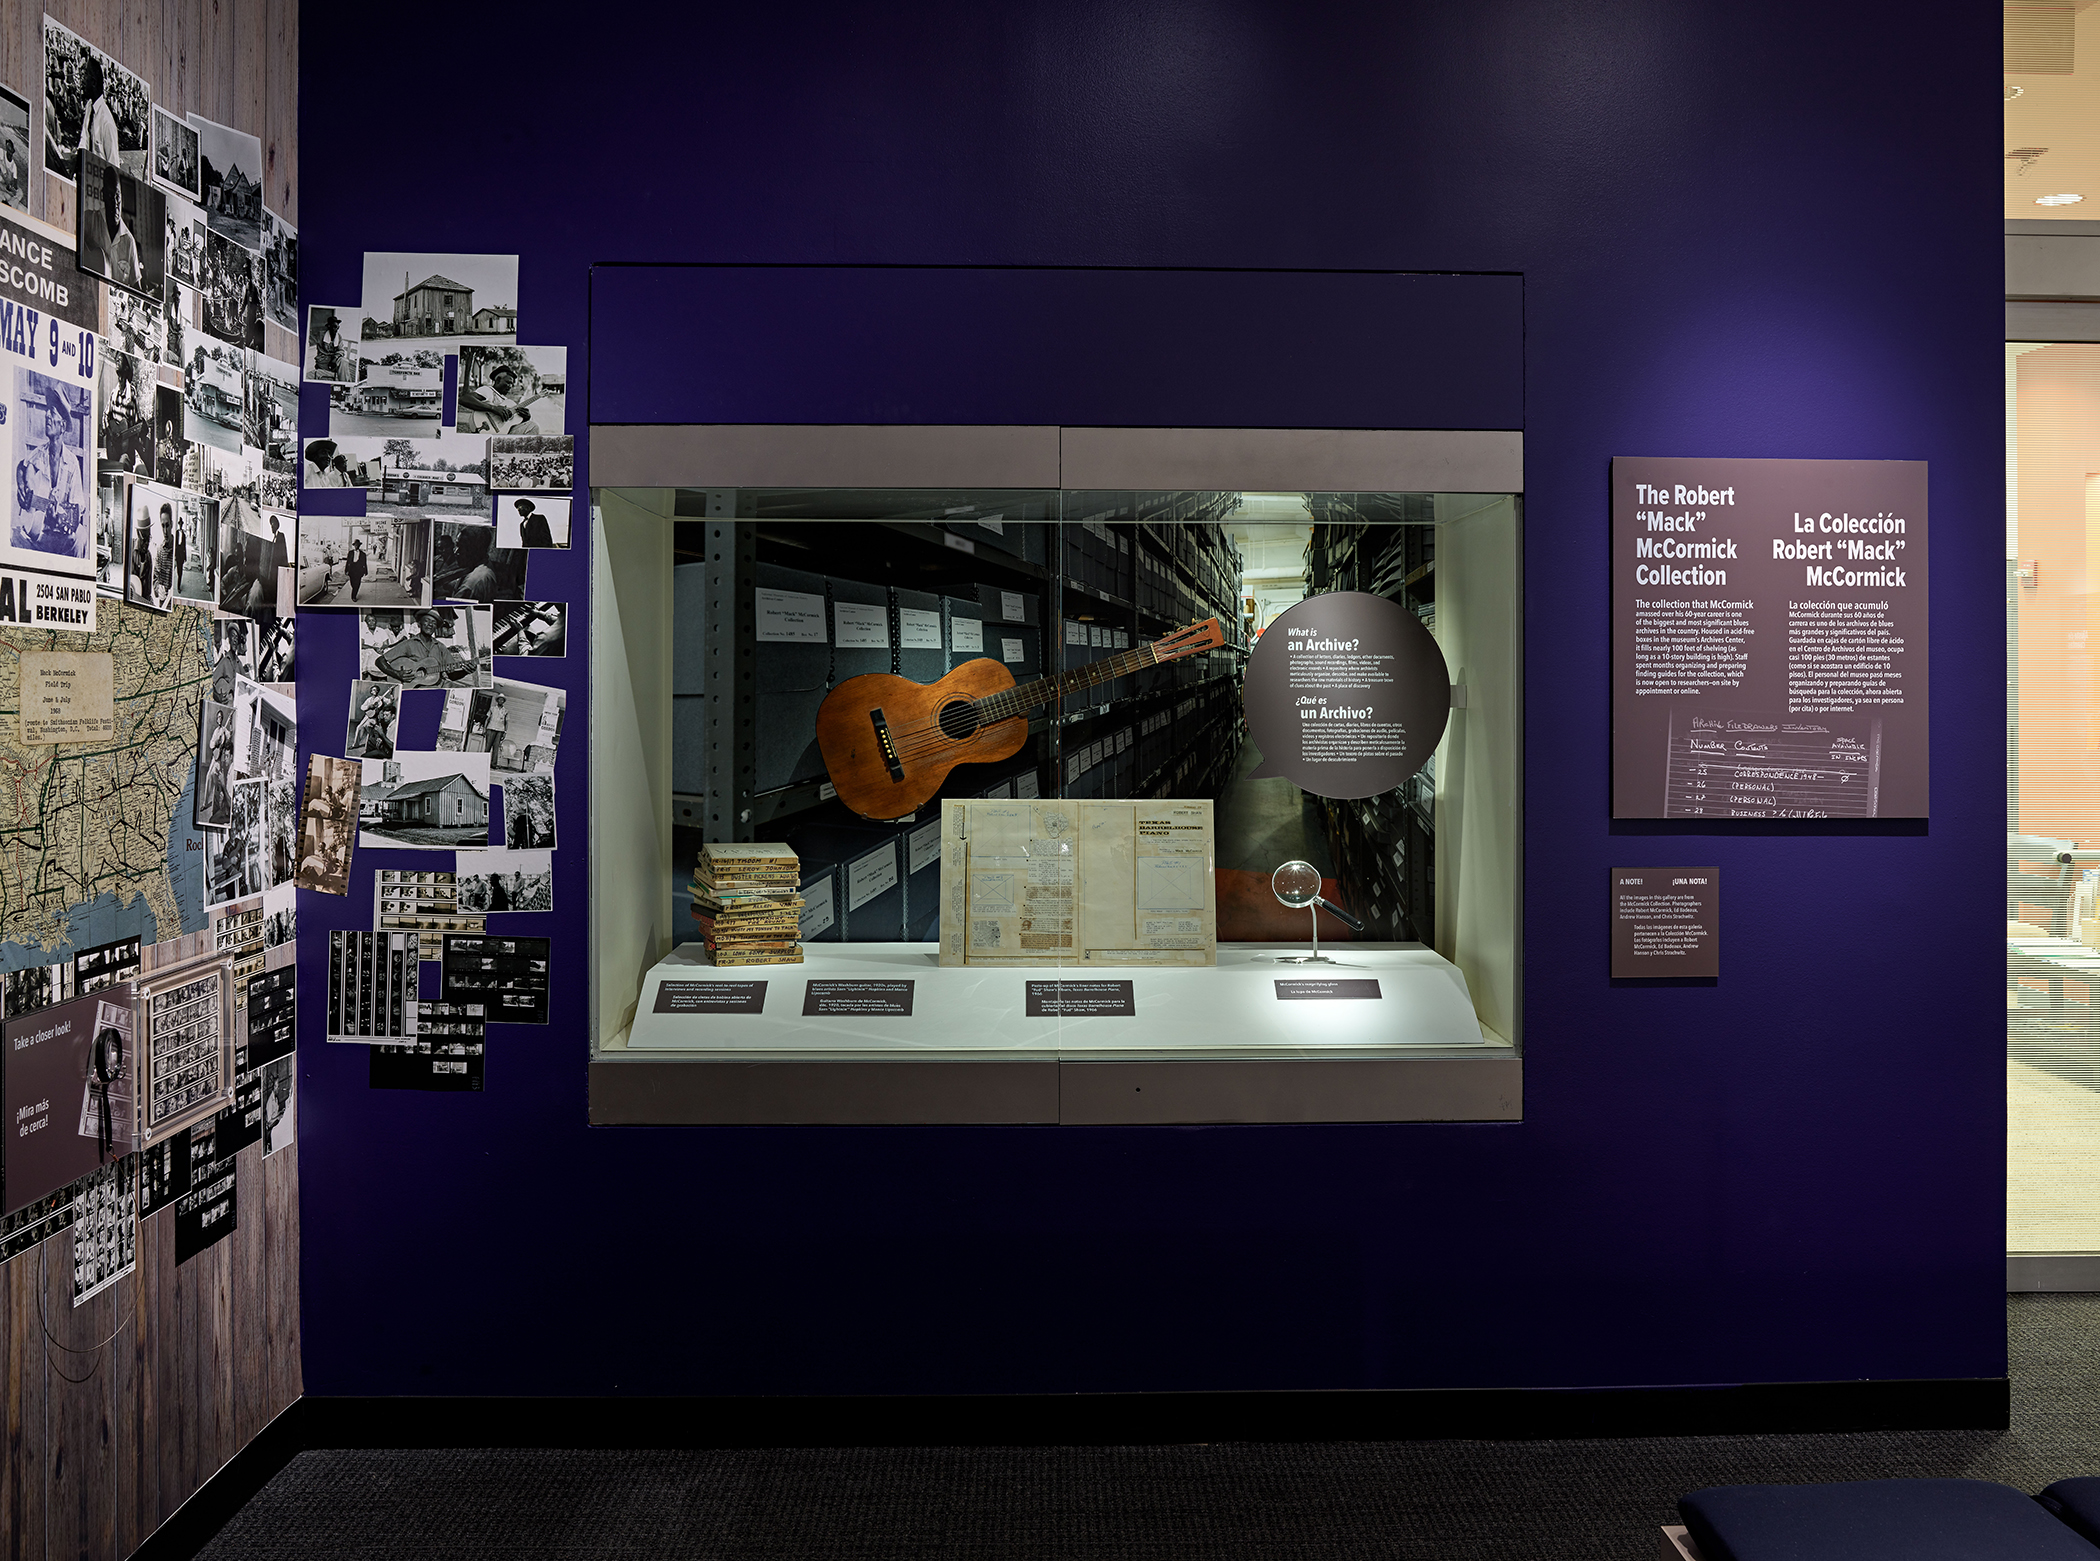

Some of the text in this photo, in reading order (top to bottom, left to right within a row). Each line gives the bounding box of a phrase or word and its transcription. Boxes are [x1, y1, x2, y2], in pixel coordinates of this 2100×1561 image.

[50, 318, 59, 367] 9
[62, 340, 76, 357] AND
[78, 331, 94, 379] 10
[1636, 485, 1735, 506] The Robert
[1794, 512, 1905, 534] La Colección
[1636, 538, 1737, 559] McCormick
[1773, 540, 1832, 560] Robert
[1636, 564, 1727, 585] Collection
[1806, 566, 1906, 587] McCormick
[36, 584, 91, 604] 2504 SAN PABLO
[1636, 599, 1754, 608] The collection that McCormick
[36, 605, 89, 625] BERKELEY
[1789, 601, 1888, 611] La colección que acumuló
[1288, 628, 1317, 636] What is
[1653, 619, 1674, 627] biggest
[1703, 619, 1732, 627] significant
[1288, 638, 1359, 651] an Archive?
[1295, 695, 1317, 706] ¿Qué
[1301, 706, 1373, 719] un Archivo?
[1673, 878, 1688, 886] ¡UNA
[14, 1020, 71, 1051] Take a closer look!
[16, 1098, 50, 1124] ¡Mira más
[19, 1114, 48, 1137] de cerca!
